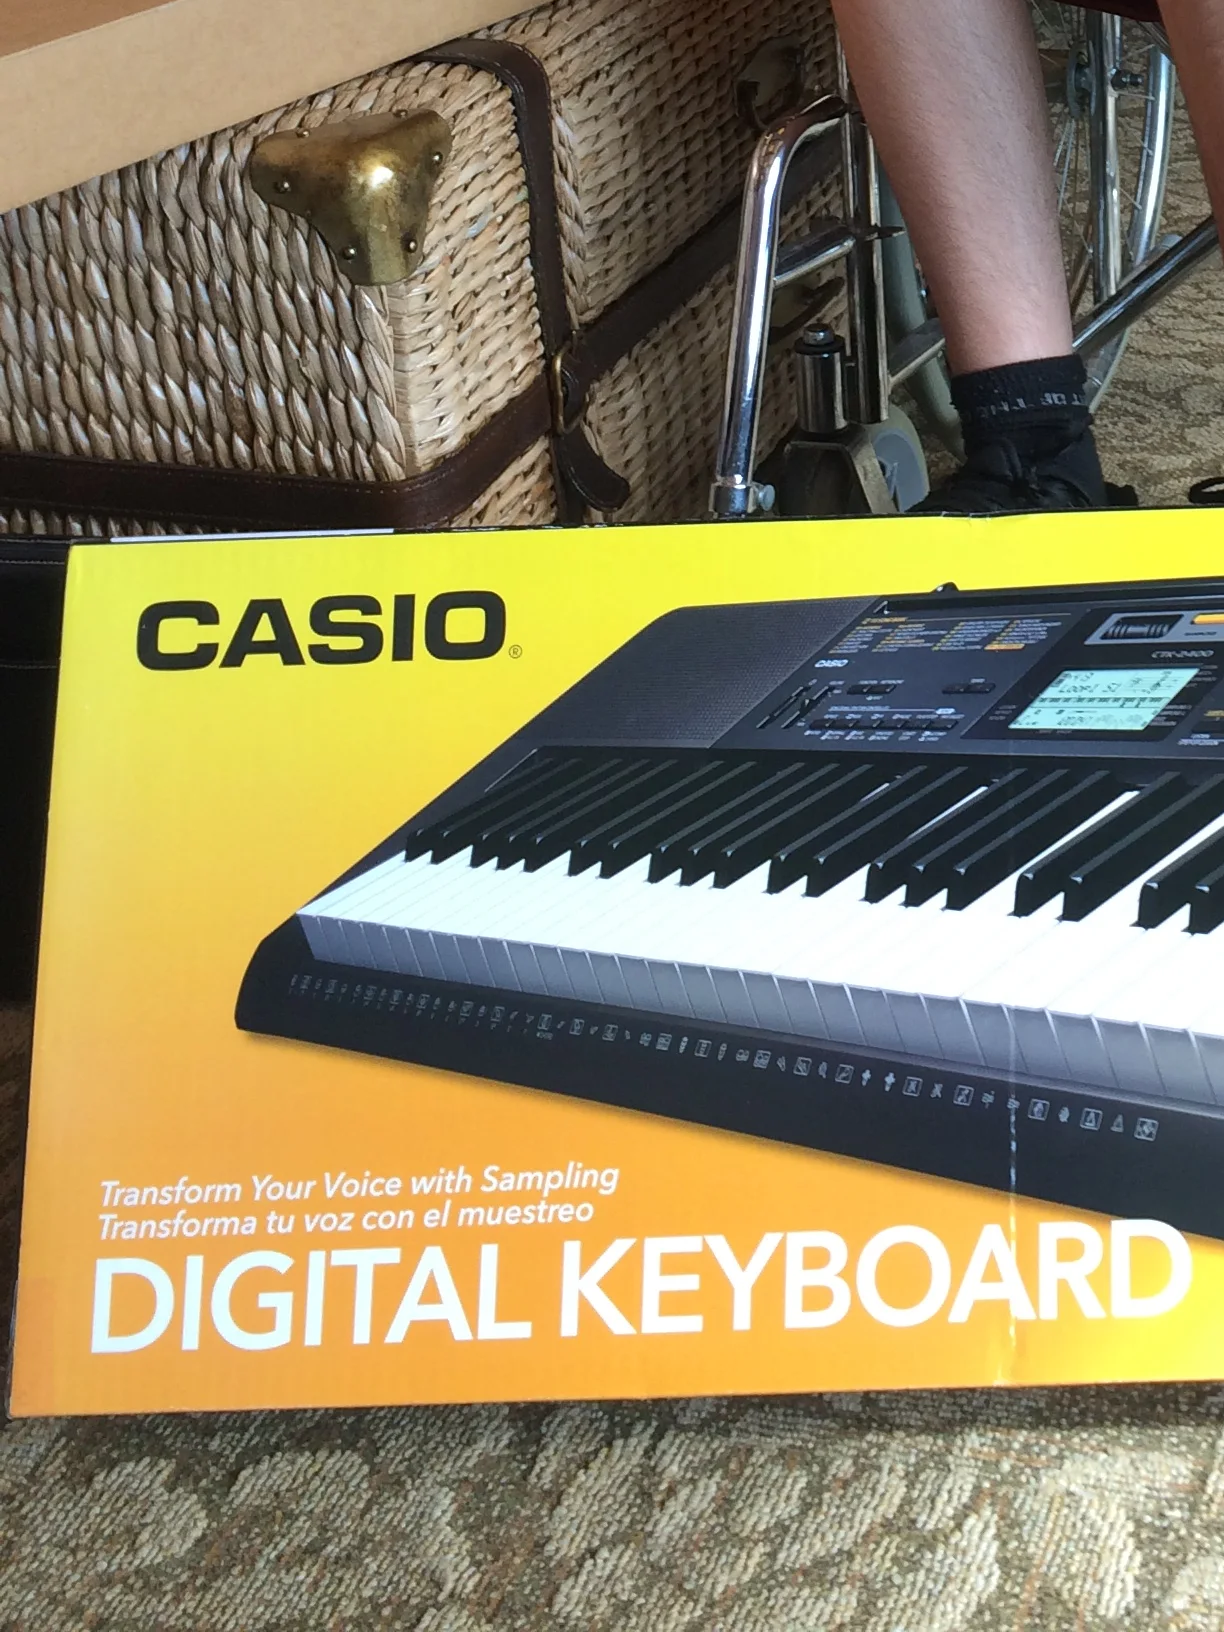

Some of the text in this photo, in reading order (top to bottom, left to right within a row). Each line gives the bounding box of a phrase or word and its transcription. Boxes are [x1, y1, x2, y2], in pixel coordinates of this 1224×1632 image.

[136, 590, 507, 672] CASIO
[100, 1161, 619, 1207] Transform Your Voice with Sampling
[99, 1196, 594, 1241] Transforma tu voz con el muestreo
[90, 1218, 1194, 1356] DIGITAL KEYBOARD
